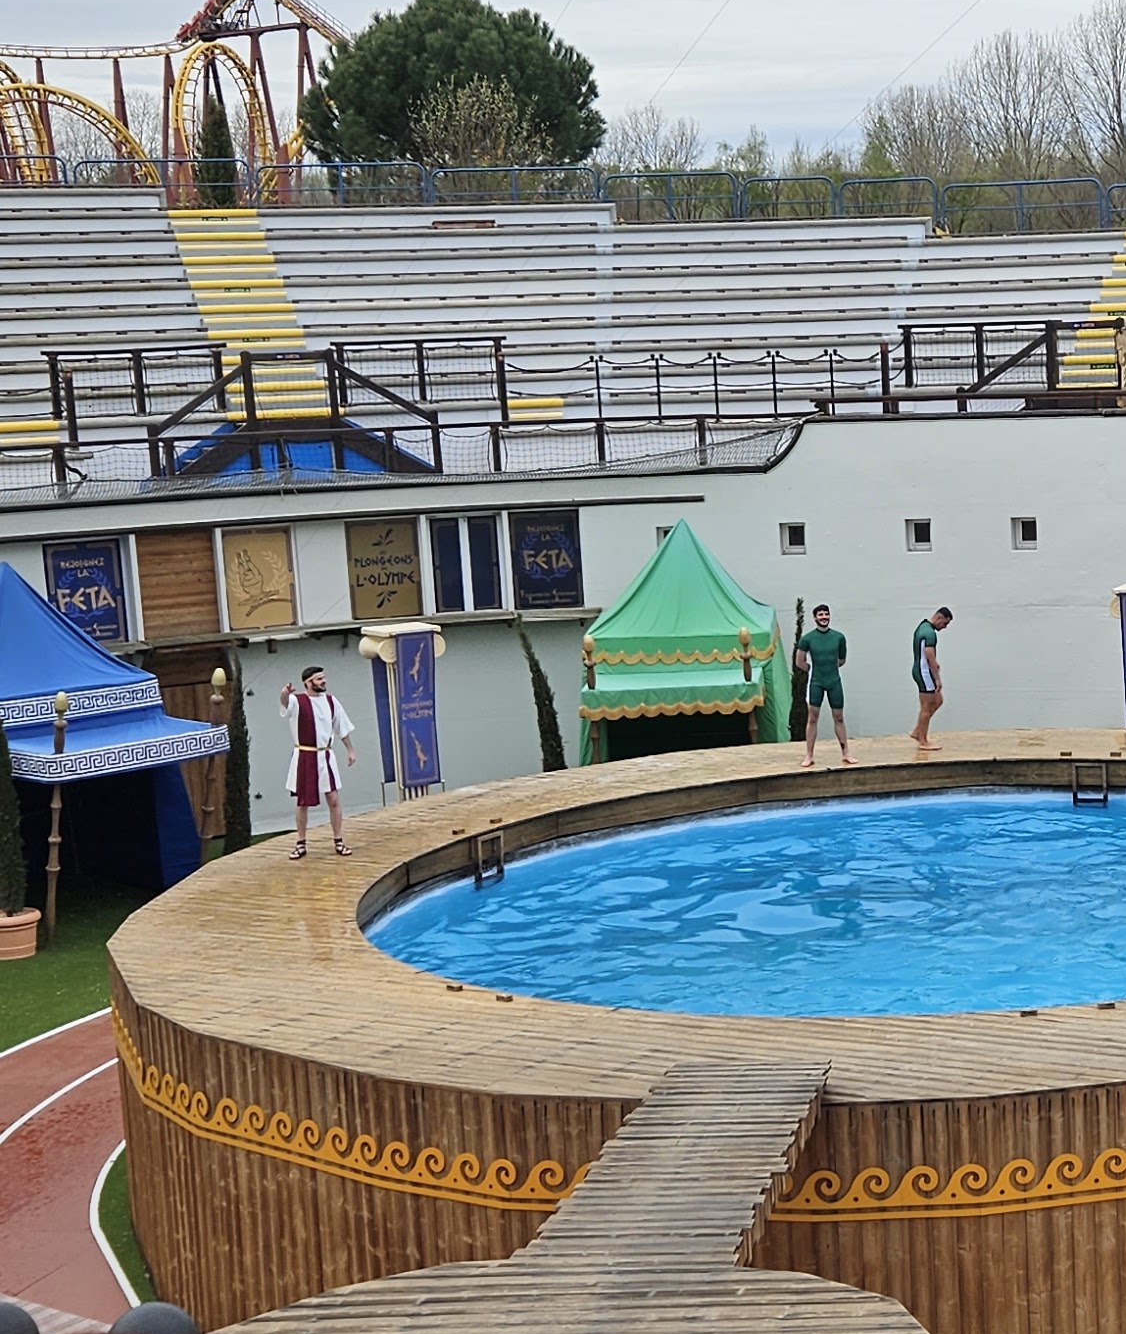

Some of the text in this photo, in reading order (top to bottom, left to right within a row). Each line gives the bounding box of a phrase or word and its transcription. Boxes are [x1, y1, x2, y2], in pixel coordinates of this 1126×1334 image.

[354, 554, 413, 567] PLONGEONS
[523, 548, 573, 570] FETA
[77, 569, 89, 578] LA
[57, 585, 116, 612] FETA
